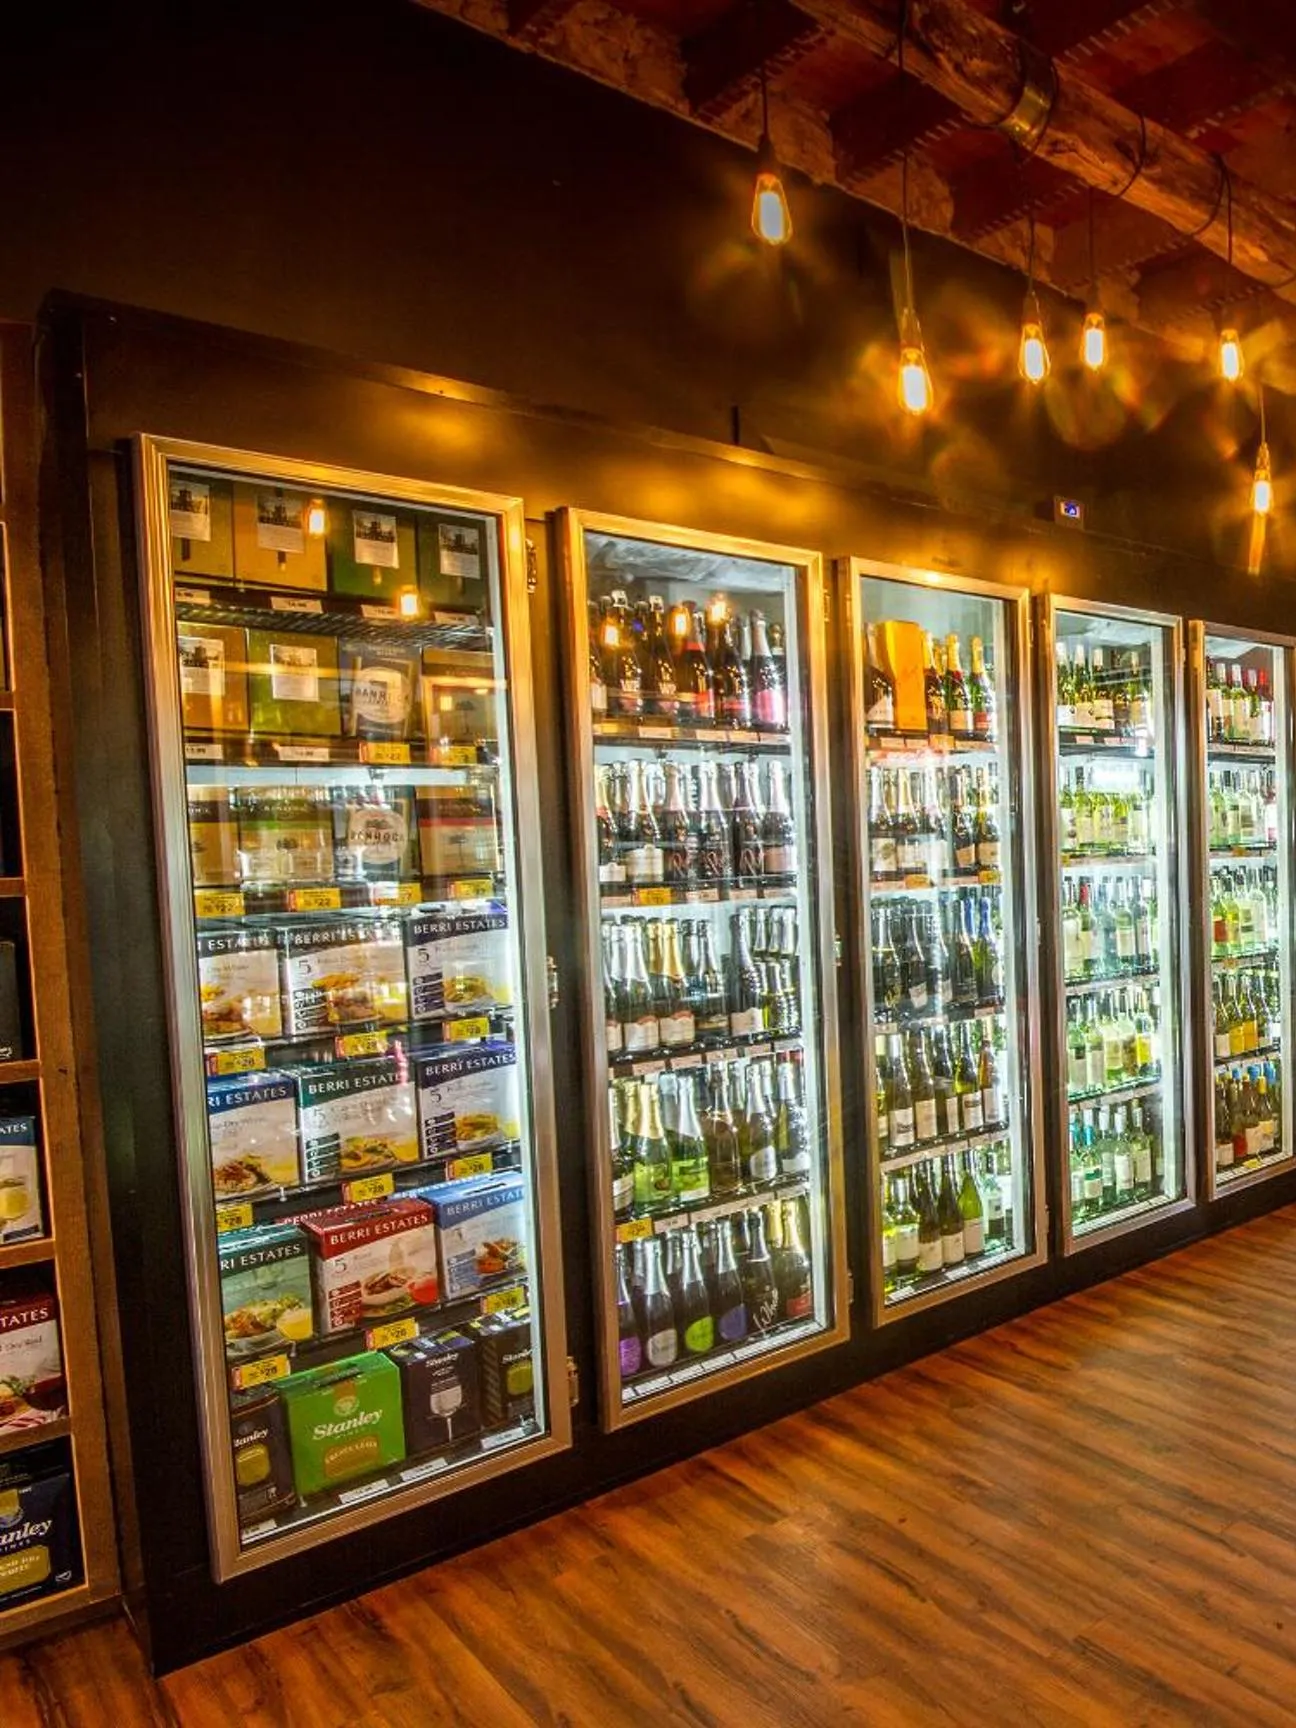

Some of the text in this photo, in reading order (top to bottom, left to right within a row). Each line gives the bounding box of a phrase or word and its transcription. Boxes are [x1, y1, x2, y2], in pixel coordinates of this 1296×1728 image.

[413, 920, 450, 935] BERRI
[455, 915, 507, 932] ESTATES
[425, 1051, 517, 1077] BERRI ESTATES
[308, 1071, 404, 1095] BERRI ESTATE
[226, 1086, 287, 1106] ESTATES
[0, 1122, 28, 1135] ATES
[447, 1199, 487, 1216] BERRI
[330, 1213, 429, 1246] BERRI ESTATES
[241, 1244, 301, 1266] ESTATES
[0, 1306, 50, 1328] TATES
[312, 1408, 384, 1441] Stanley
[0, 1519, 53, 1547] anley
